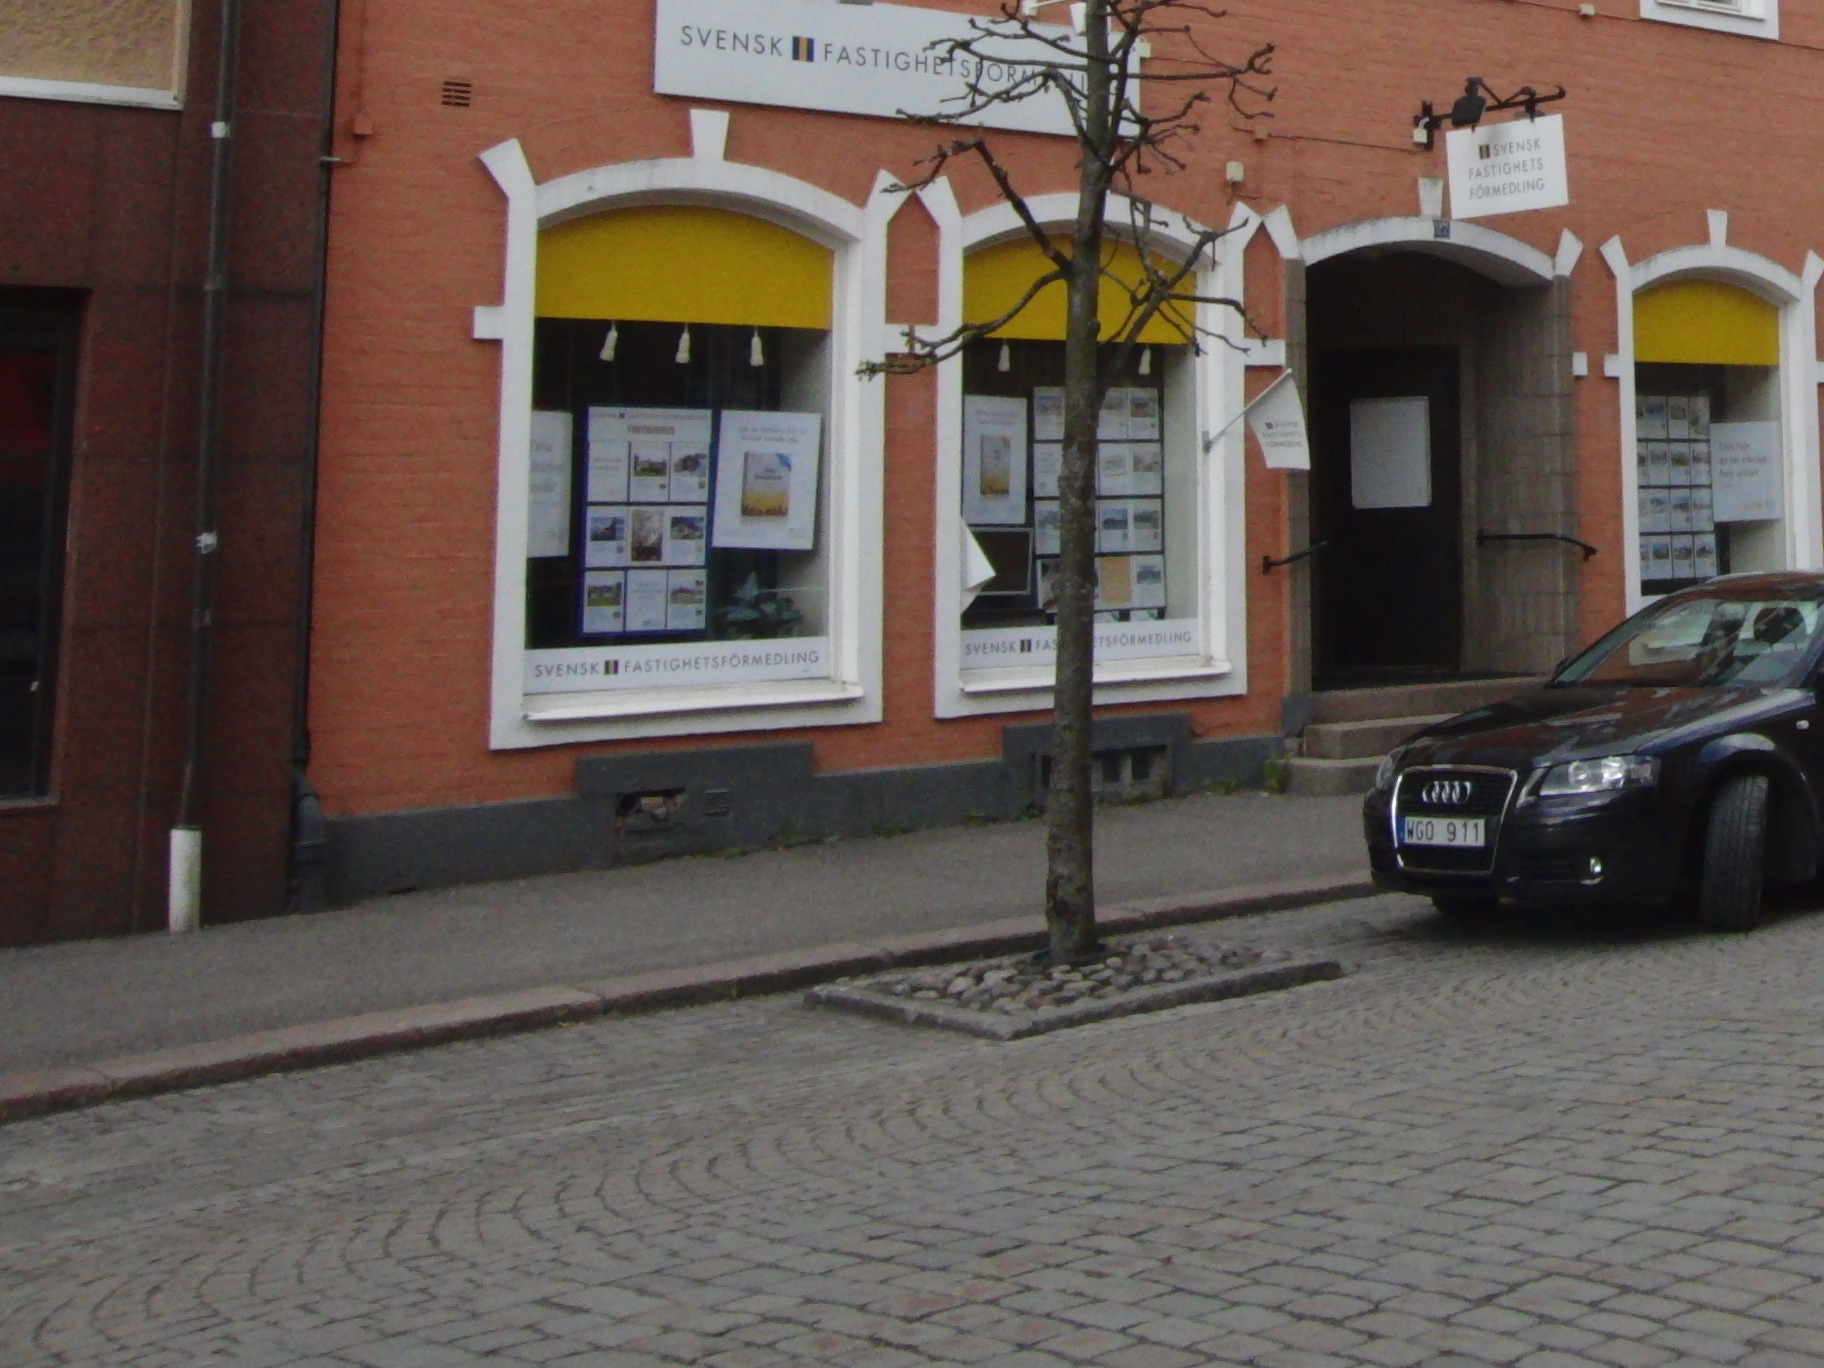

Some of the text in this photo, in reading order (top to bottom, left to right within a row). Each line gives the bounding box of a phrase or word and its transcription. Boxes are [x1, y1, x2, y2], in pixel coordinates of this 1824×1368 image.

[681, 25, 783, 57] SVENSK
[1493, 138, 1541, 156] SVENSK
[1468, 157, 1544, 180] FASTIGHETS
[1469, 178, 1545, 200] FÖRMEDLING
[965, 640, 1017, 656] SVENSK
[534, 649, 820, 678] SVENSK FASTIGHETSFÖRMEDLING
[1407, 820, 1480, 843] WGO 911
